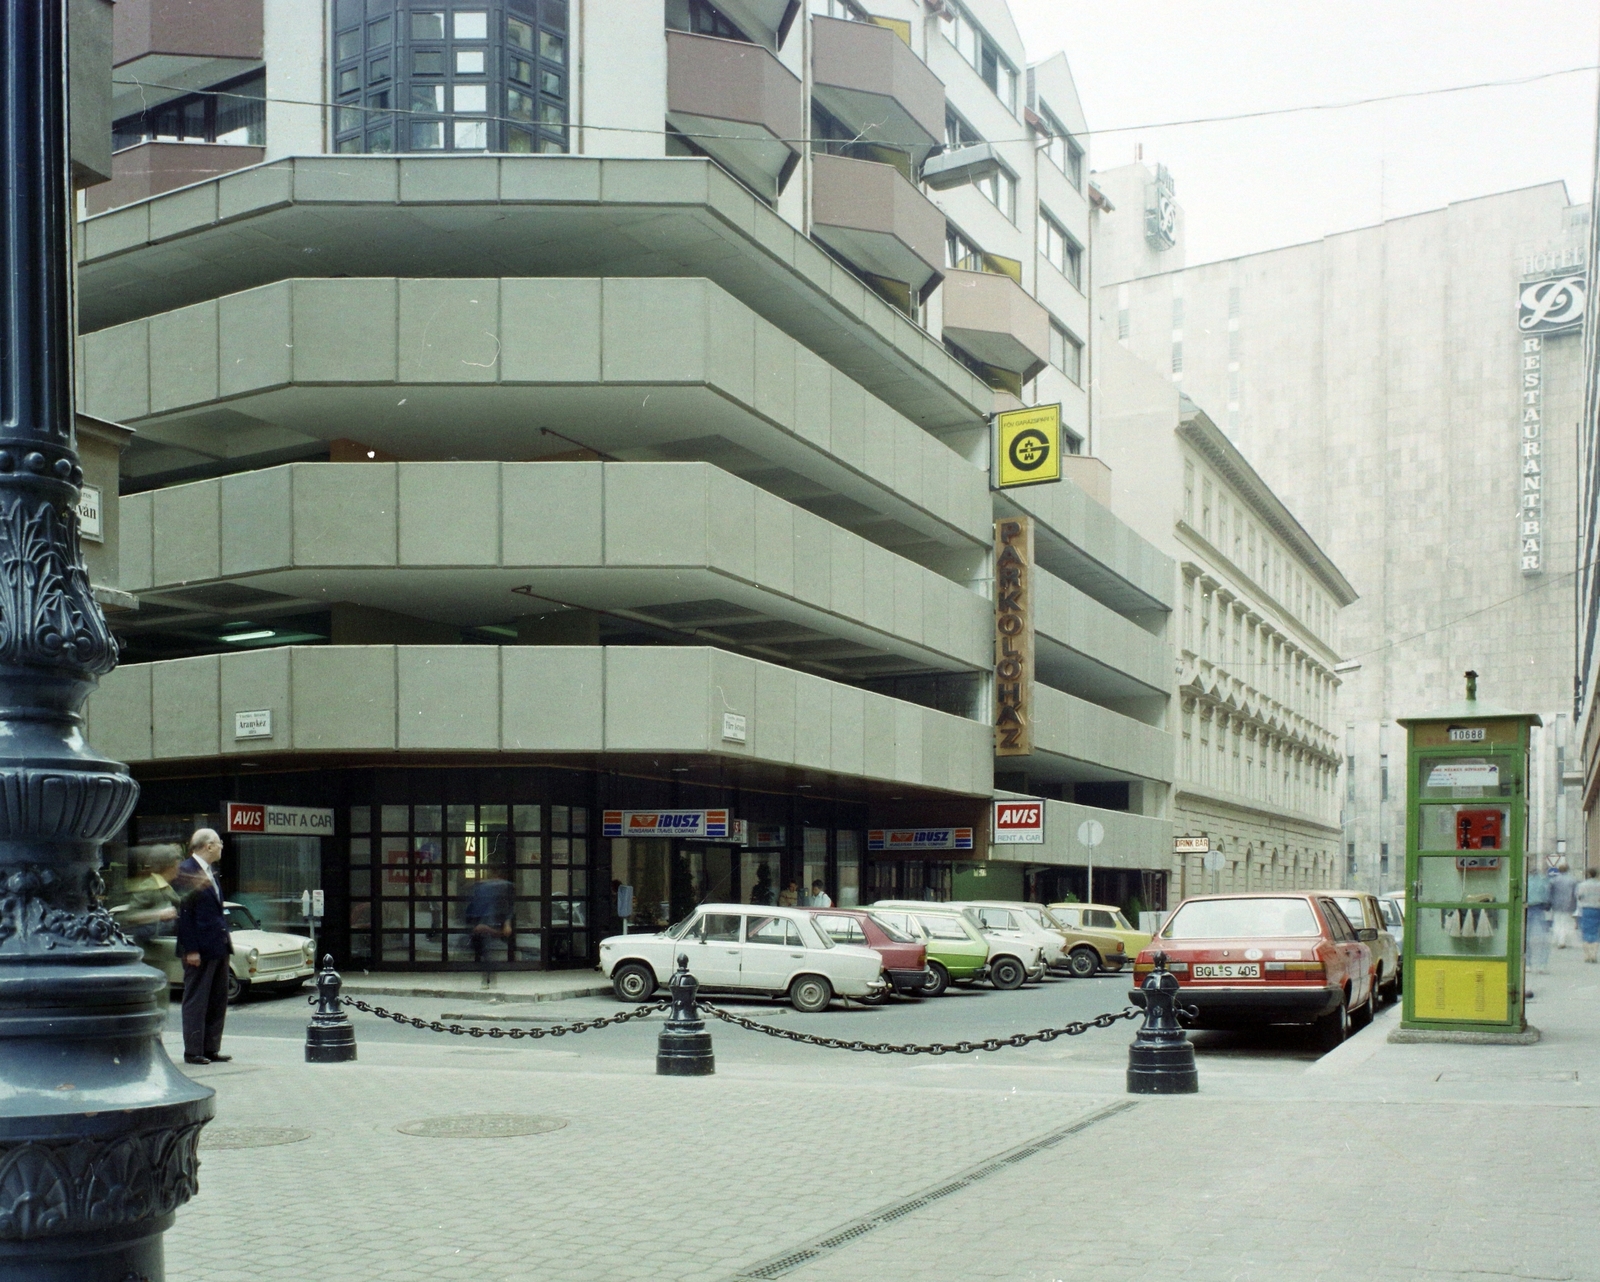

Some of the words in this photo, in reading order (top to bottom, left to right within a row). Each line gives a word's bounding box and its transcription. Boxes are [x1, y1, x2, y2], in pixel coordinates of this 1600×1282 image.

[1524, 247, 1583, 274] HOTEL
[1522, 338, 1541, 508] RESTAURANT
[1521, 521, 1540, 570] BAR
[996, 522, 1024, 748] PARKOLÓHÁZ
[1454, 730, 1483, 739] 10688
[233, 811, 262, 826] AVIS
[268, 812, 298, 826] RENT
[300, 814, 308, 827] A
[310, 814, 332, 828] CAR
[1000, 809, 1038, 824] AVIS
[1175, 839, 1193, 847] DRINK
[1195, 839, 1208, 847] BAR
